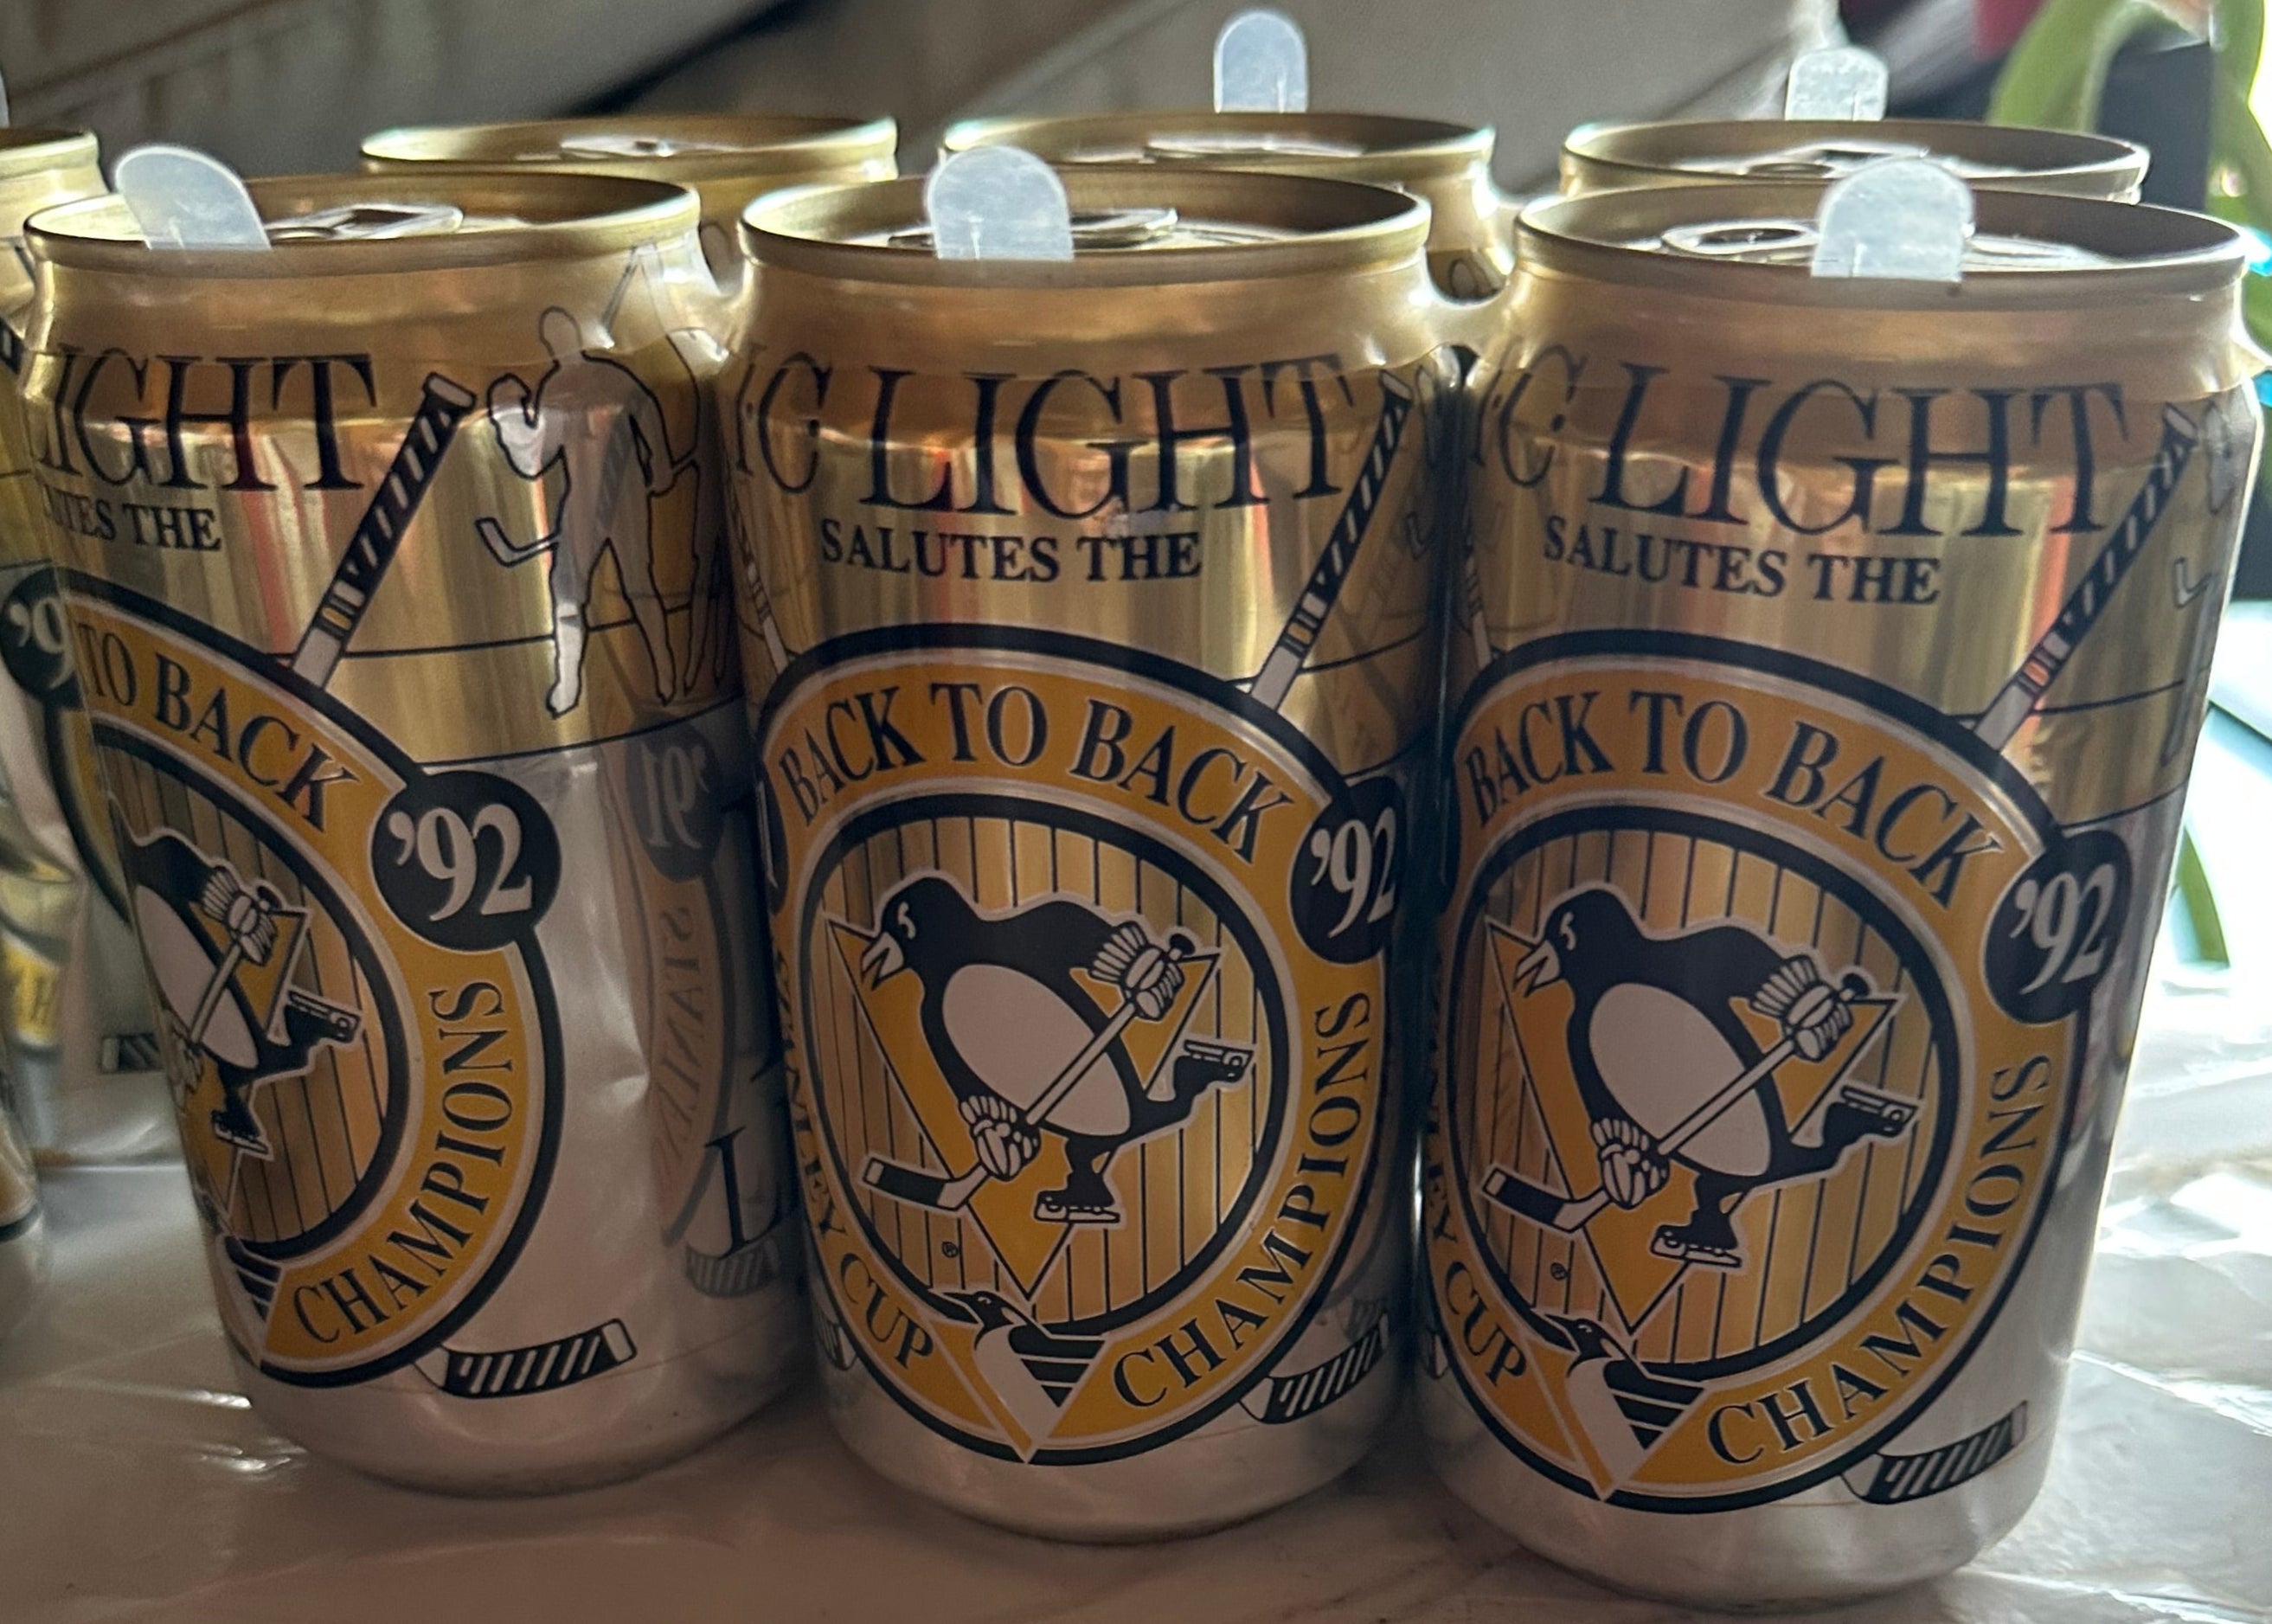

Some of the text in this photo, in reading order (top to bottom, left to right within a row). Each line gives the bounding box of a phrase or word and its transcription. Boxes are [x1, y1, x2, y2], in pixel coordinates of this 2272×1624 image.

[40, 343, 377, 491] IGHT
[859, 353, 1355, 520] LIGHT
[1588, 361, 2134, 537] LIGHT
[121, 503, 221, 551] THE
[822, 519, 1202, 584] SALUTES THE
[1544, 516, 1941, 607] SALUTES THE
[76, 622, 362, 833] TO BACK
[779, 682, 1294, 864] BACK TO BACK
[1466, 691, 2006, 911] BACK TO BACK
[387, 802, 534, 921] '92
[1311, 806, 1396, 939] '92
[2009, 862, 2120, 997] '92
[292, 980, 514, 1345] CHAMPIONS
[1112, 992, 1372, 1409] CHAMPIONS
[838, 1250, 936, 1370] CUP
[1445, 1261, 1527, 1386] CUP
[1706, 1052, 2053, 1465] CHAMPIONS
